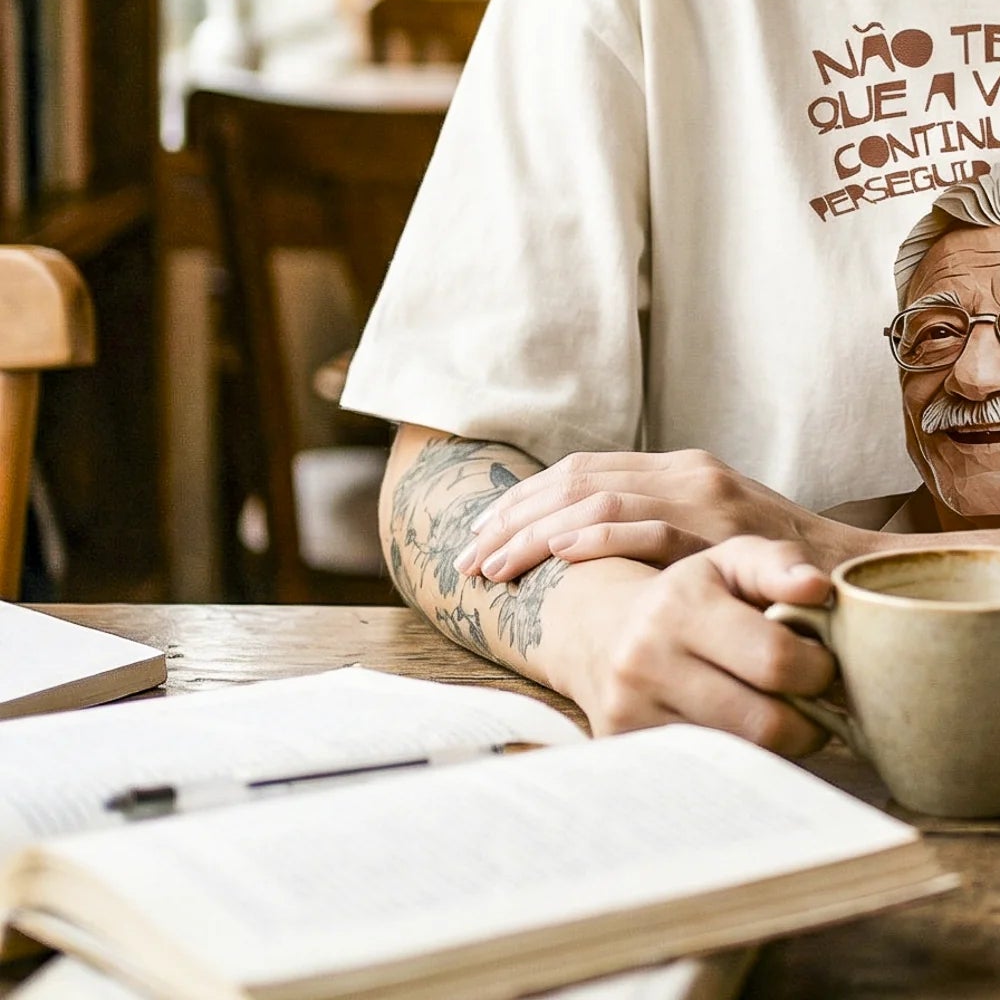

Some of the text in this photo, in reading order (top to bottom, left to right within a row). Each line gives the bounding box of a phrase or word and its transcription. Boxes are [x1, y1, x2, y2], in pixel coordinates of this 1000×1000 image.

[813, 21, 934, 85] NÃO
[807, 80, 907, 135] QUE
[925, 72, 956, 113] A
